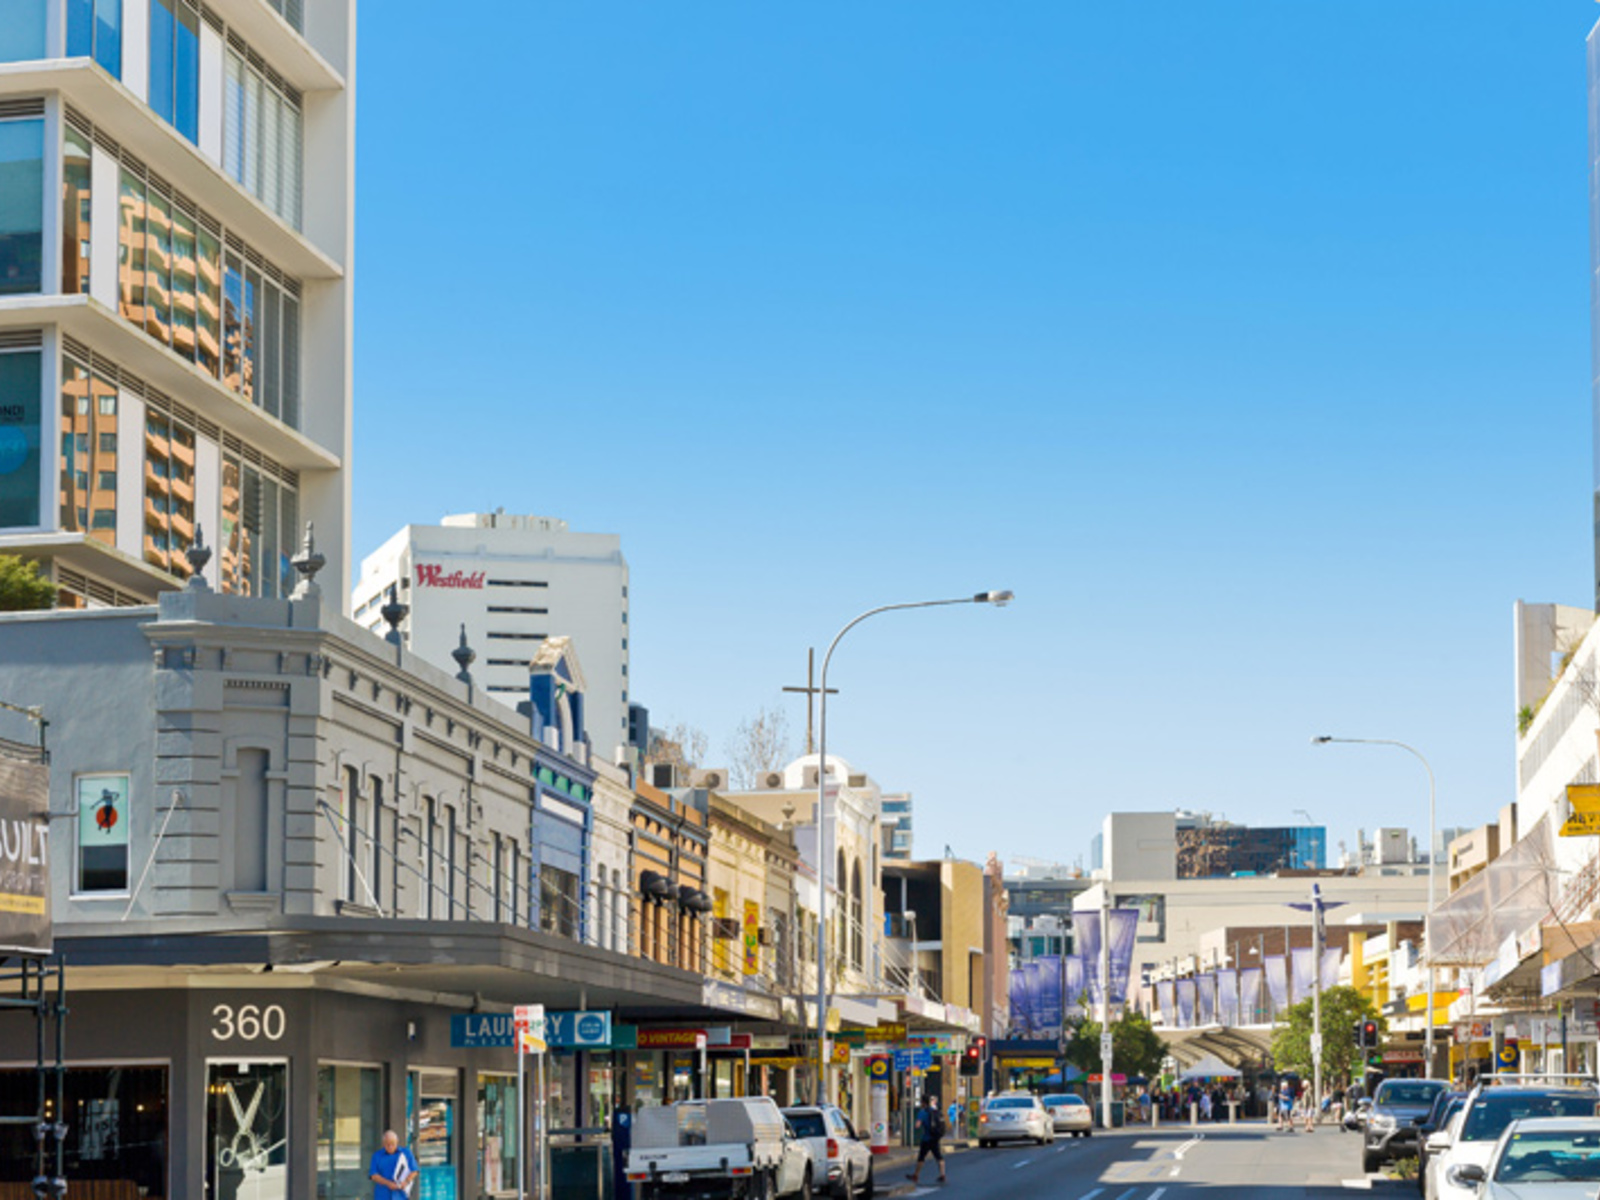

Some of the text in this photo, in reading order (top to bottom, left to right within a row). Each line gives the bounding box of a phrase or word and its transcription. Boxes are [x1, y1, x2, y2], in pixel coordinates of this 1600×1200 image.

[414, 563, 487, 589] Westfield
[0, 818, 49, 866] UILT
[211, 1003, 286, 1041] 360
